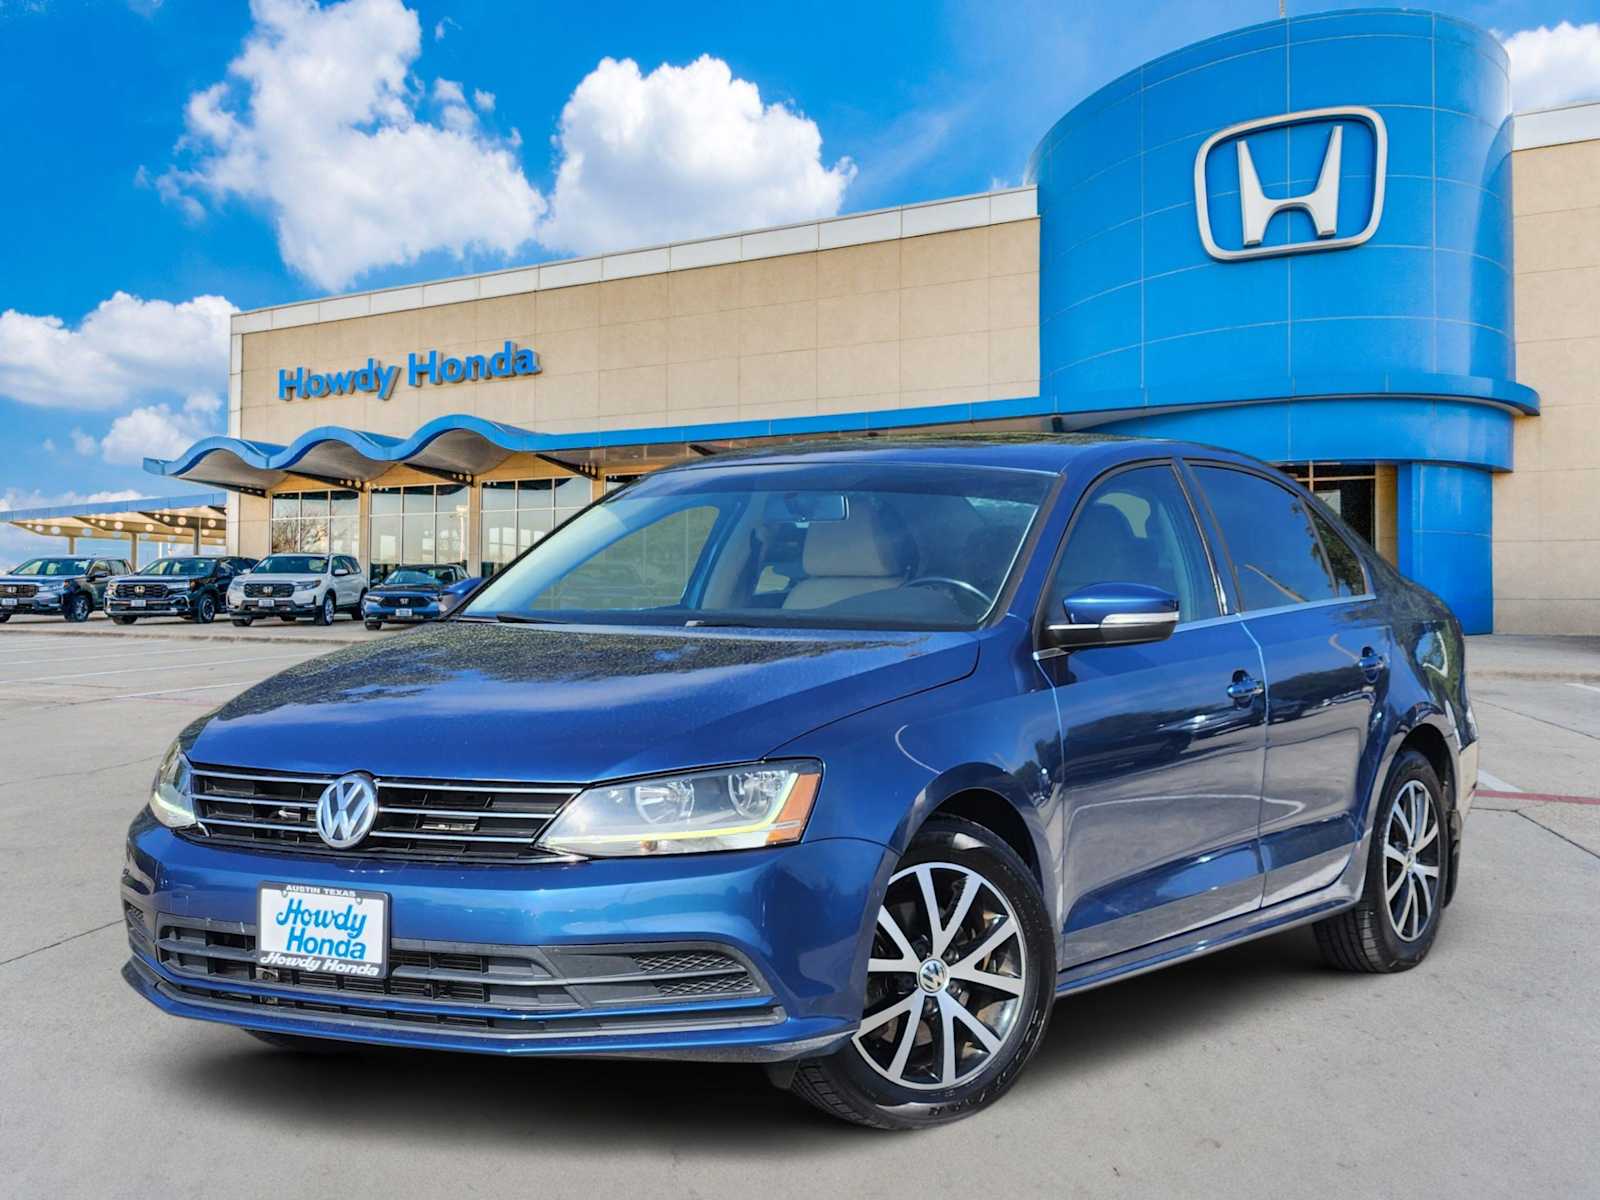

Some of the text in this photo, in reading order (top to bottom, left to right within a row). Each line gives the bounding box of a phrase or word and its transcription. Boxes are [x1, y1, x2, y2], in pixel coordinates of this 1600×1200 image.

[278, 340, 543, 401] Howdy Honda
[285, 884, 357, 897] AUSTIN TEXAS
[275, 898, 368, 939] Howdy
[286, 926, 367, 960] Honda
[260, 951, 380, 976] Howdy Honda
